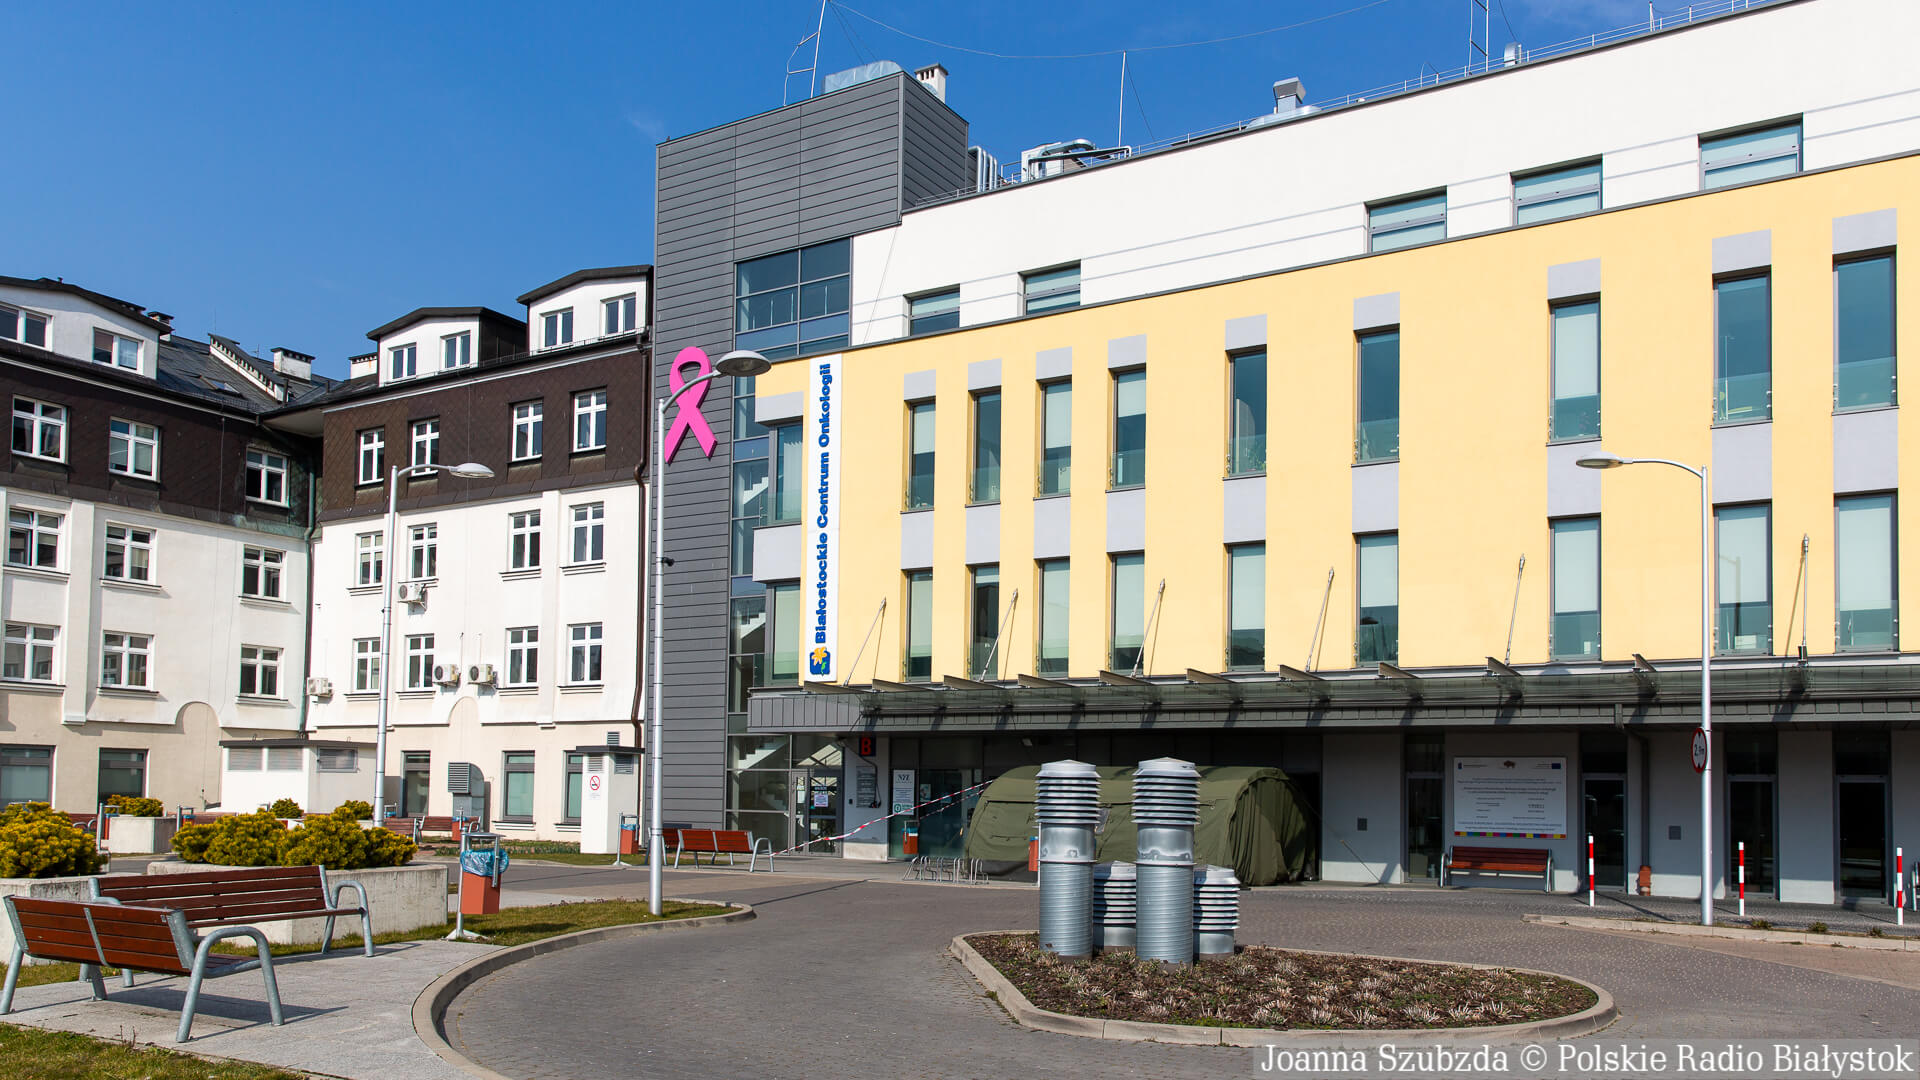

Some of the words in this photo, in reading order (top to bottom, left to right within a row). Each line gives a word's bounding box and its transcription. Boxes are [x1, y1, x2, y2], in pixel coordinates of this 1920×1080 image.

[818, 363, 832, 447] Onkologii
[817, 451, 830, 528] Centrum
[815, 532, 828, 643] Białostockie
[862, 738, 871, 756] B
